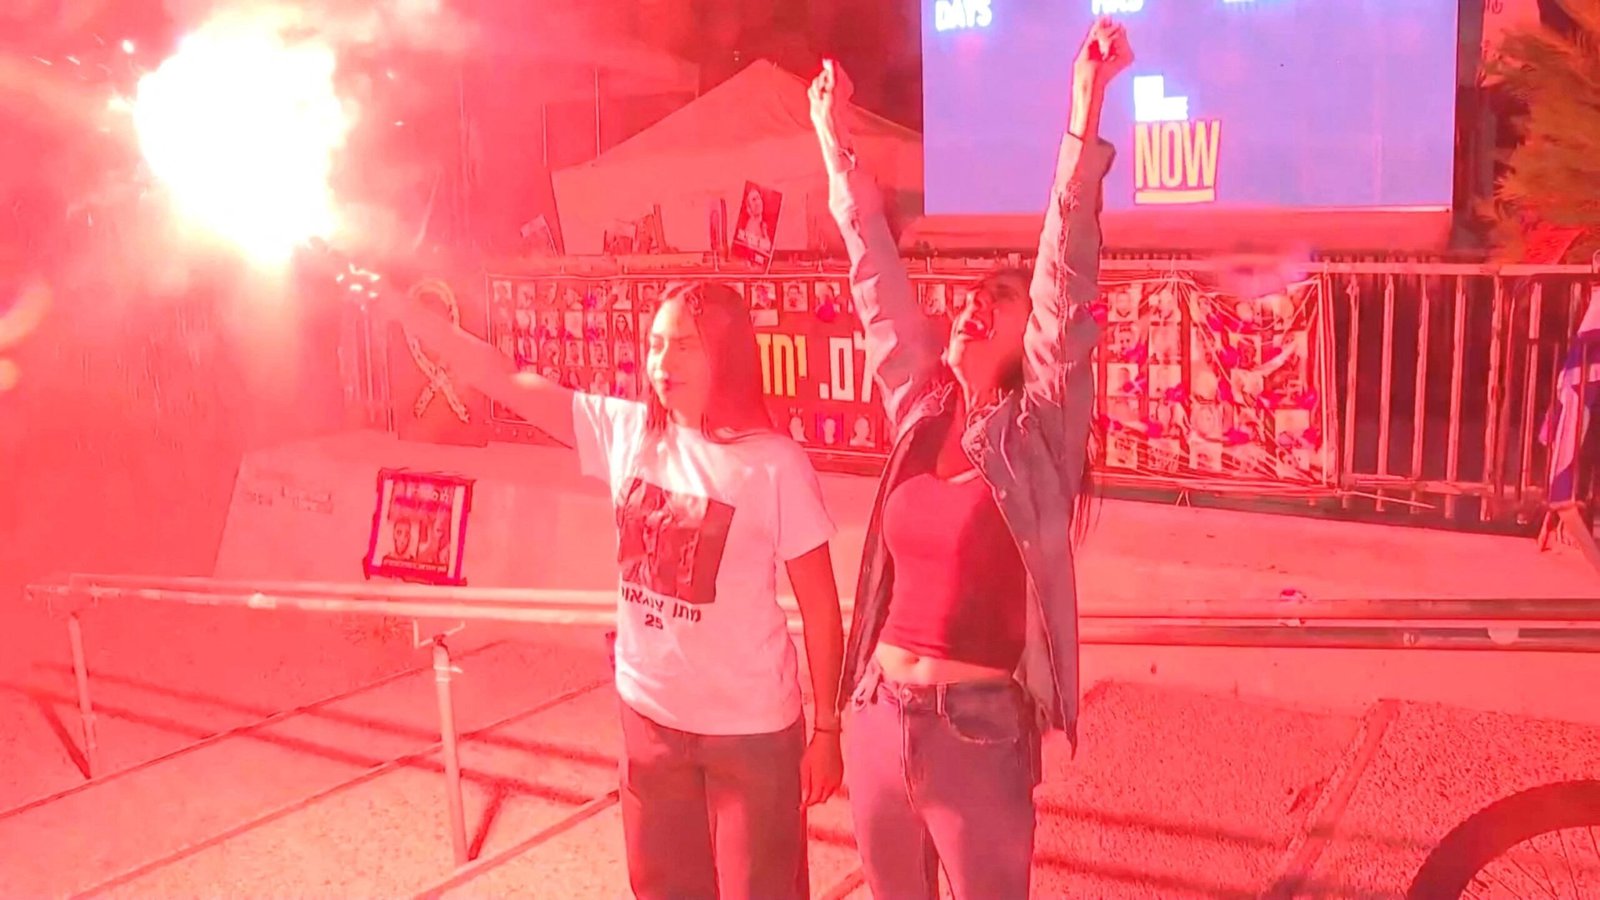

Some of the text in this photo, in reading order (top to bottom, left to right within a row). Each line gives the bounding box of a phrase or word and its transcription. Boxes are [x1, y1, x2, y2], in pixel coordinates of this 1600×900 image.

[935, 0, 992, 31] DAYS
[1134, 119, 1221, 189] NOW
[645, 613, 664, 630] 25
[672, 602, 702, 622] מתן
